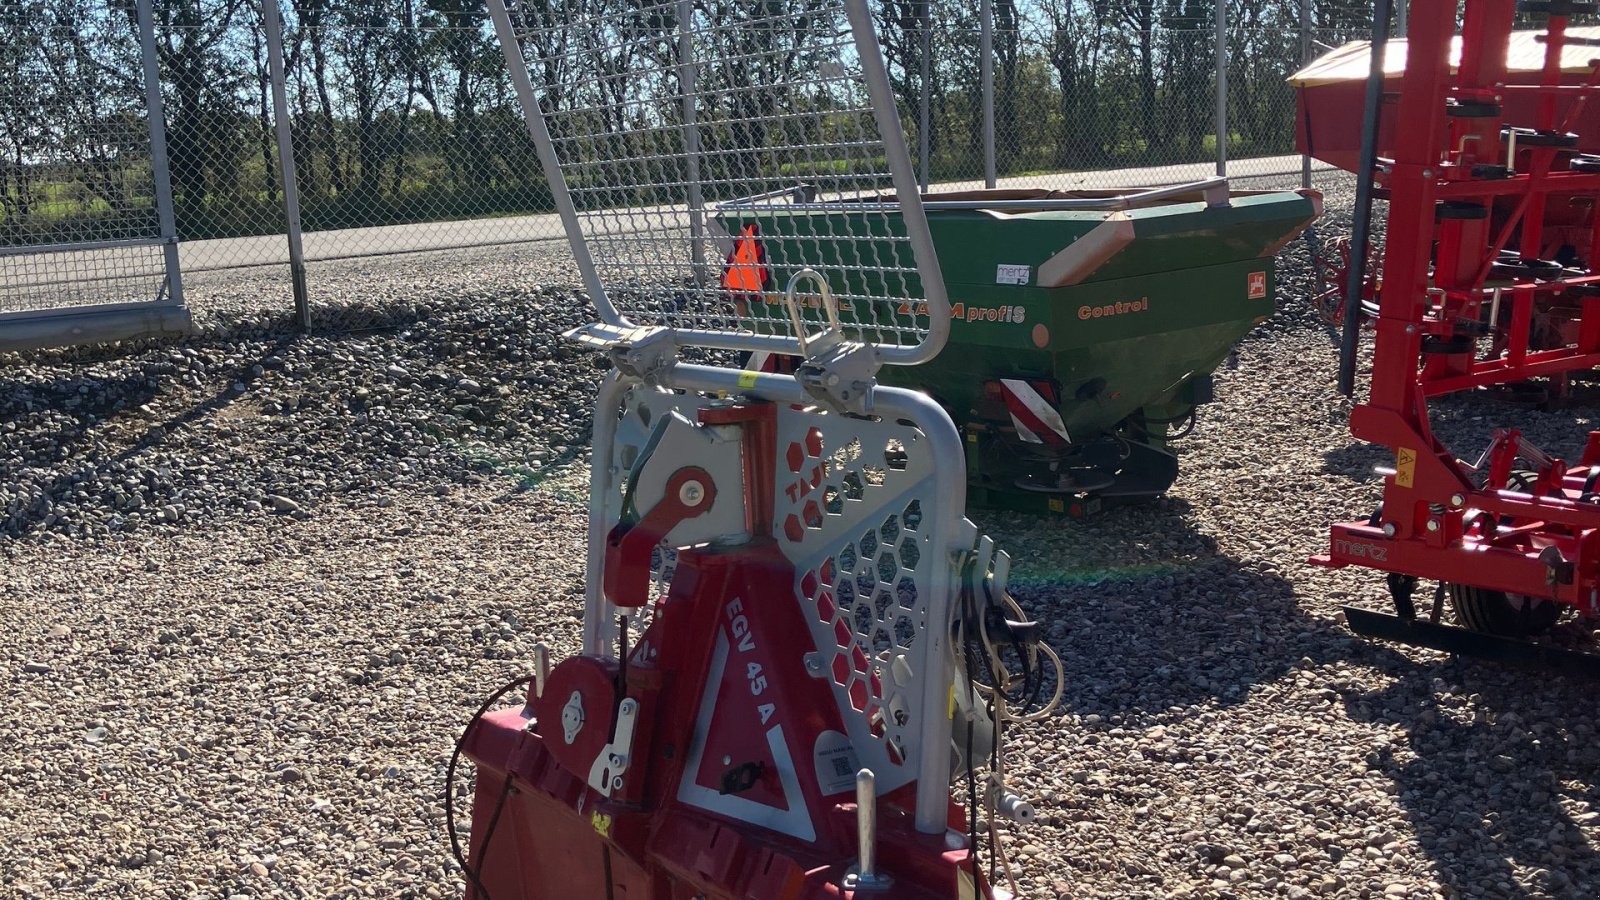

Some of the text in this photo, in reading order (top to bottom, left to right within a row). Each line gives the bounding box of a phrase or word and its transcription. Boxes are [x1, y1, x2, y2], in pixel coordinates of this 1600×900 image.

[1078, 296, 1148, 320] Control
[1334, 539, 1388, 561] mertz
[726, 596, 776, 725] EGV 45 A
